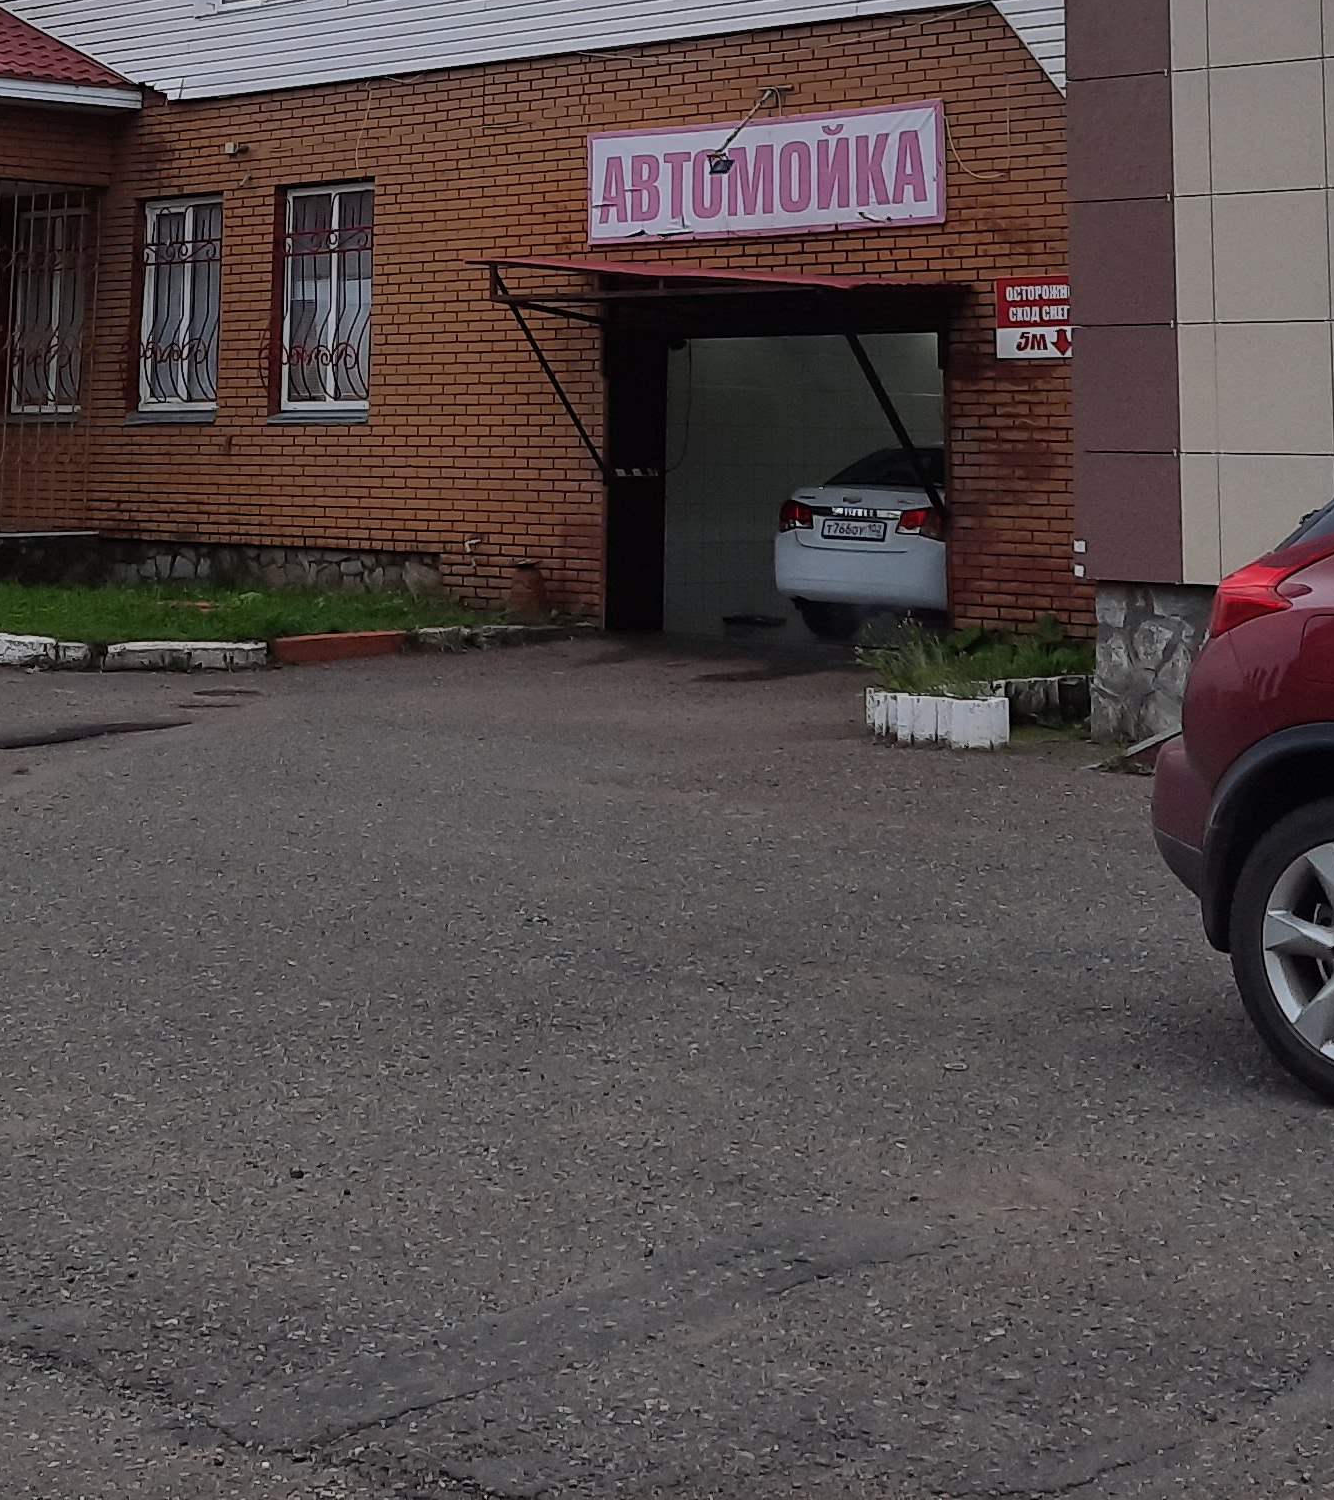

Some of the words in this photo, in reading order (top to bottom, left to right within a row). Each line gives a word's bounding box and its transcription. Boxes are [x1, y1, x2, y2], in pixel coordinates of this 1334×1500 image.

[599, 124, 928, 224] АВТОМОЙКА
[1005, 284, 1071, 302] ОСТОРОЖН
[1008, 306, 1041, 323] СХОД
